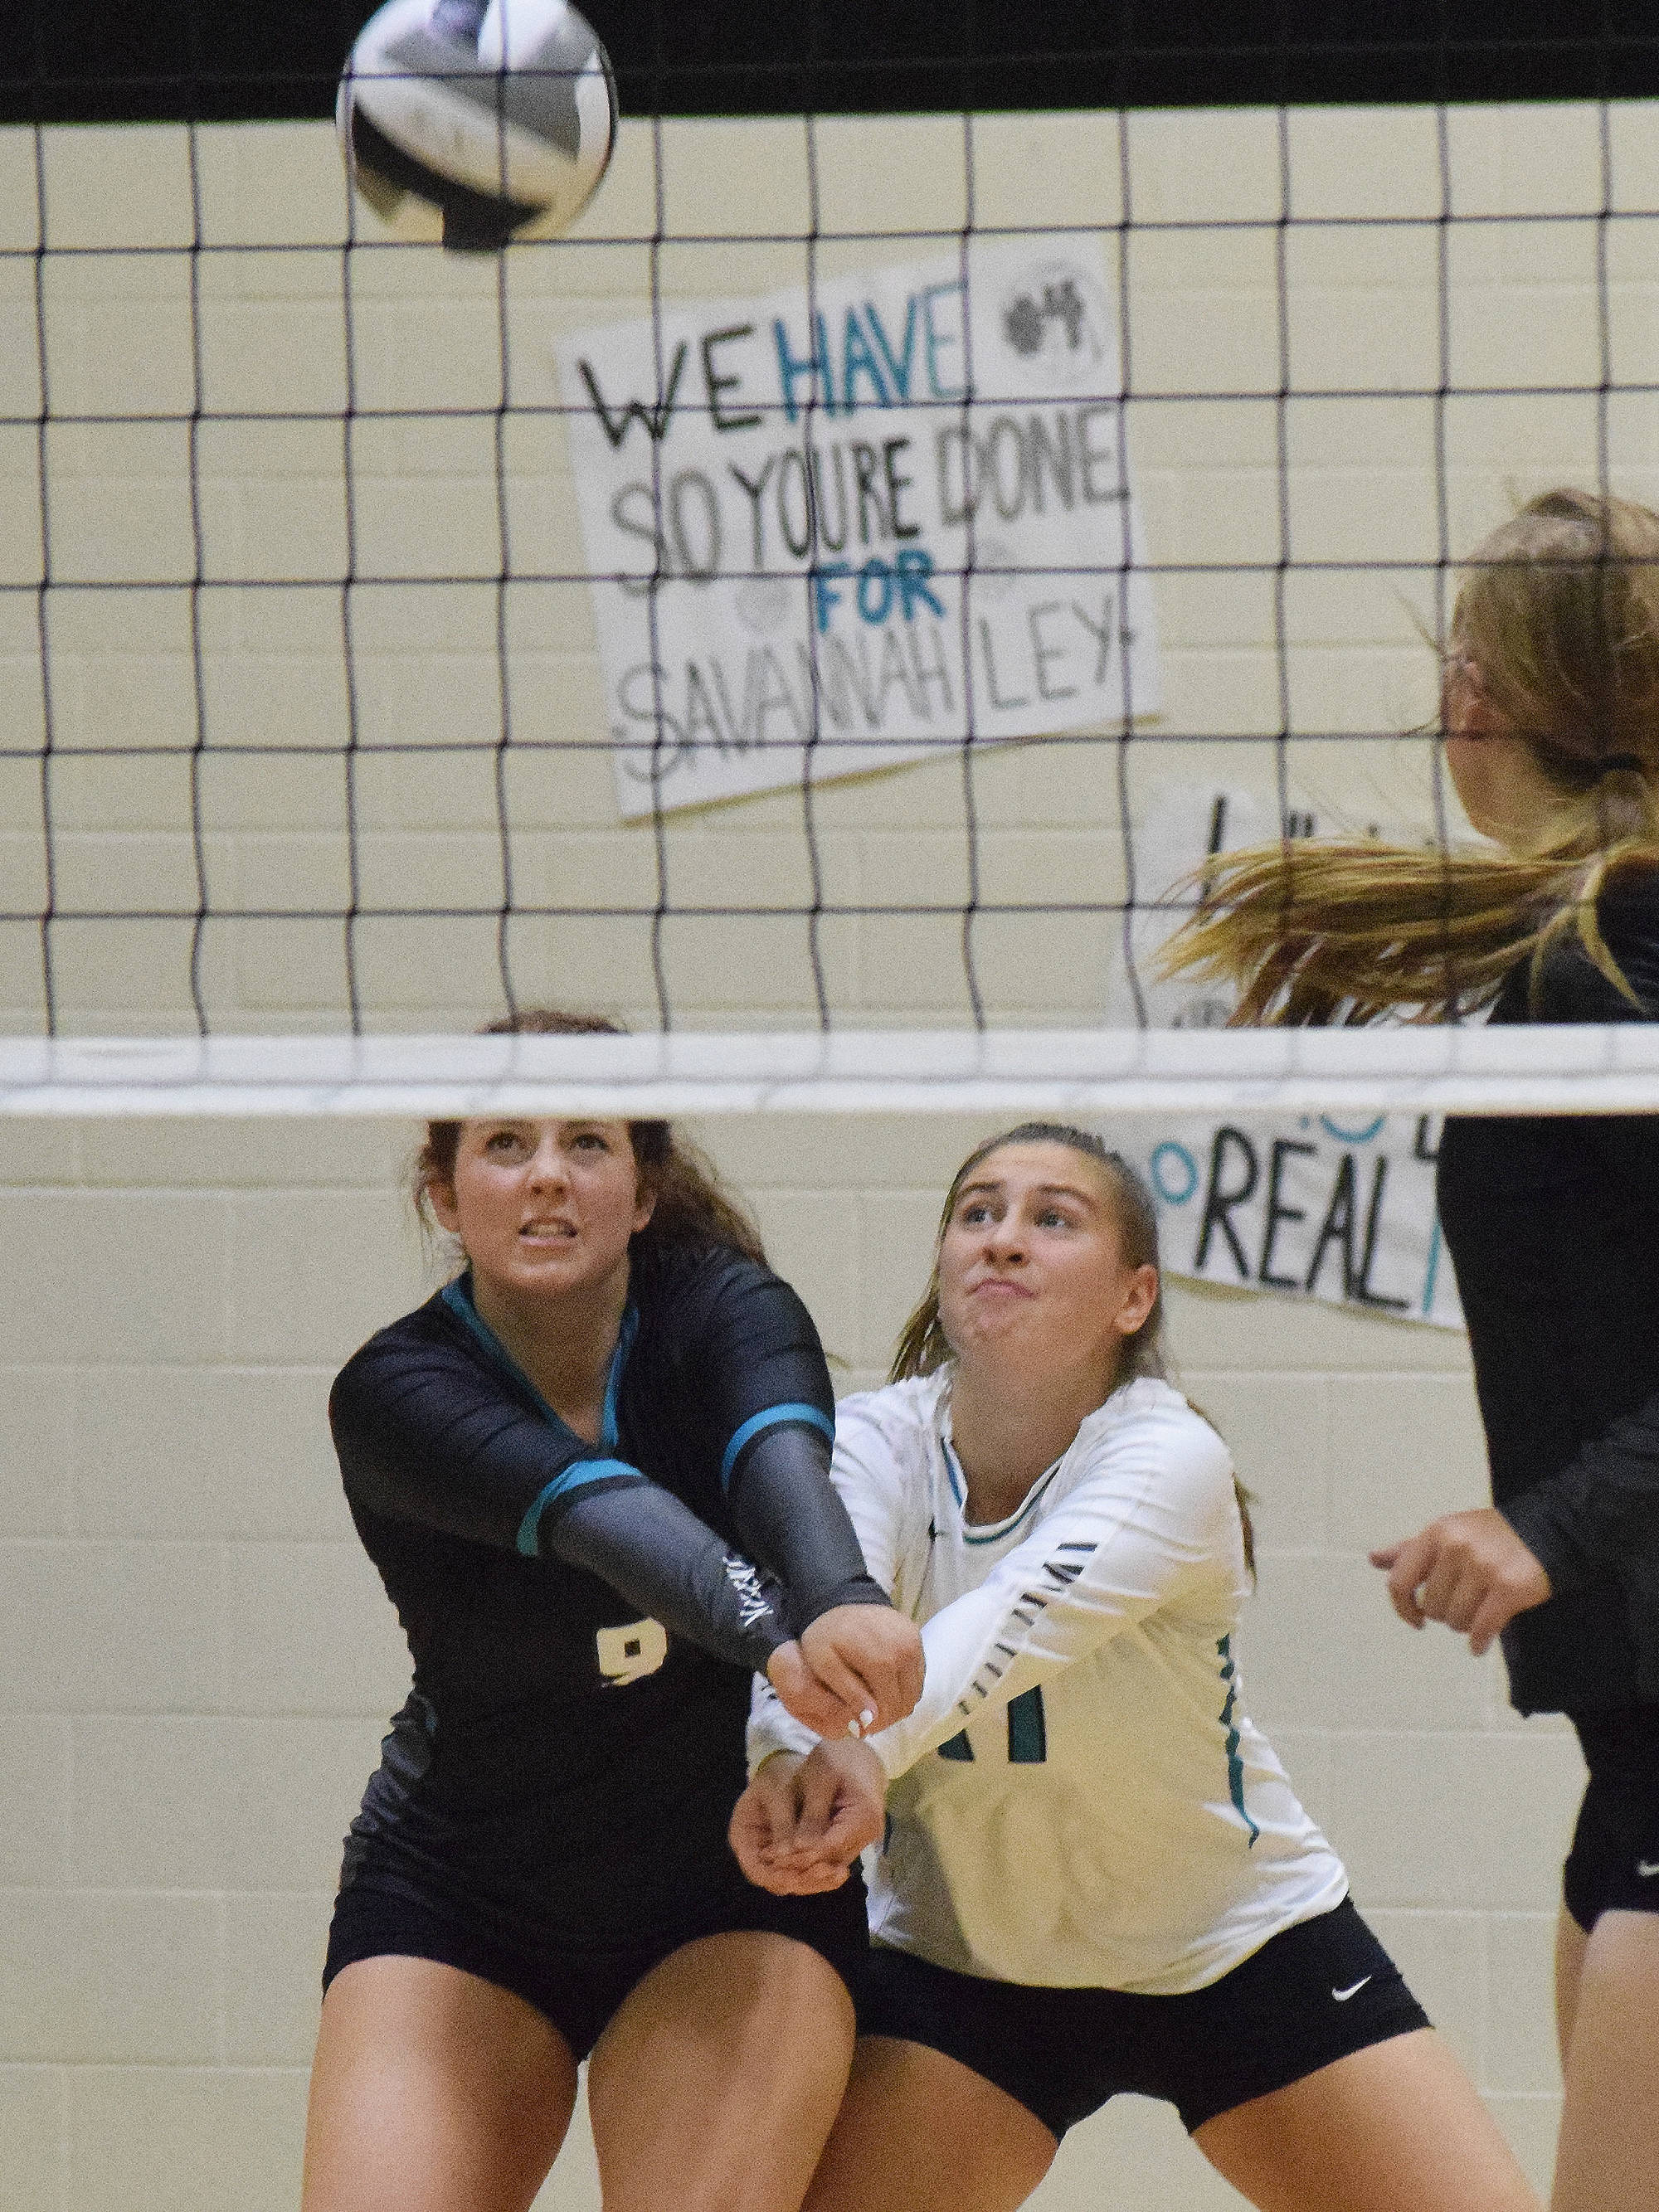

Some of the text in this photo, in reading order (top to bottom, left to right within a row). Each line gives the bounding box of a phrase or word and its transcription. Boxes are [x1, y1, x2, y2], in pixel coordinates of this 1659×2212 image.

[578, 279, 975, 450] WE HAVE
[610, 403, 1131, 598] SO YOURE DONE
[811, 549, 946, 633] FOR
[612, 595, 1114, 783] SAVANNAH LEY
[1194, 1125, 1410, 1310] REAL
[596, 1616, 667, 1689] 9
